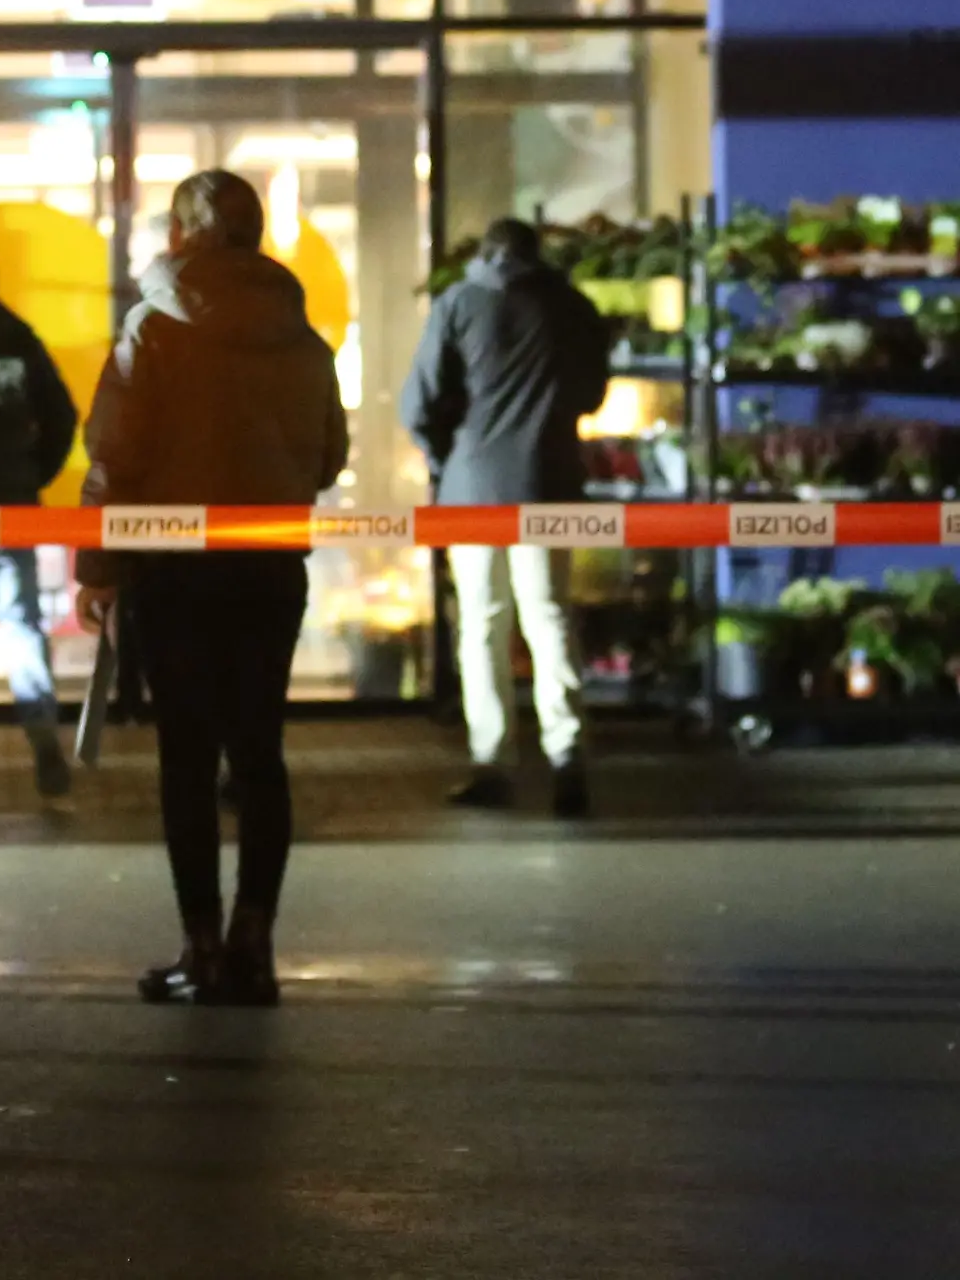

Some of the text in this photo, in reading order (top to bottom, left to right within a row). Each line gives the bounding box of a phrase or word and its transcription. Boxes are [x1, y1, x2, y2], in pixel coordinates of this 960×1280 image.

[108, 517, 198, 535] POLIZEI
[526, 515, 617, 536] POLIZEI
[736, 514, 827, 535] POLIZEI
